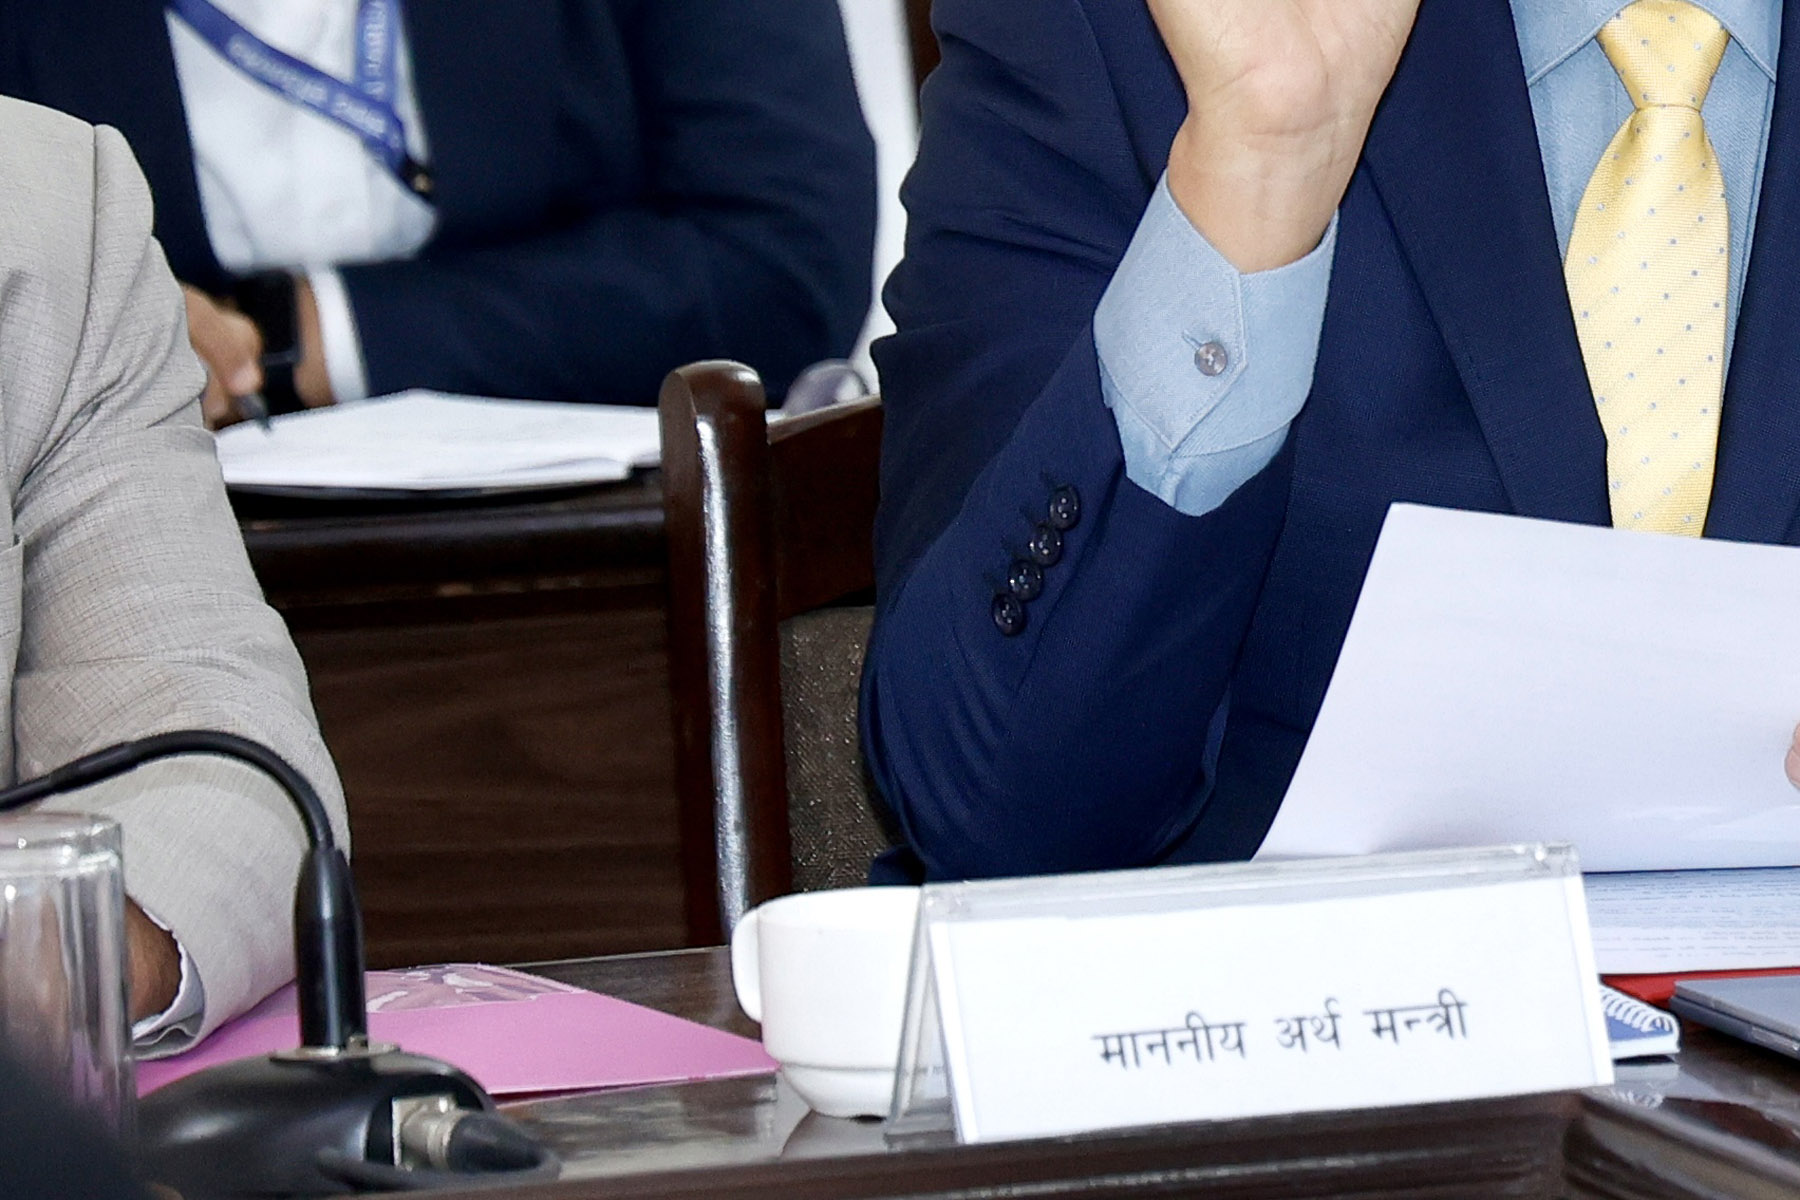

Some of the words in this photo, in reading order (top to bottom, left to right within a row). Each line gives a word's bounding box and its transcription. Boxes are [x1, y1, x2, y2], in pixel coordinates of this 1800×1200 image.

[1092, 1010, 1245, 1068] माननीय
[1275, 997, 1341, 1052] अर्थ
[1363, 987, 1467, 1042] मन्त्री
